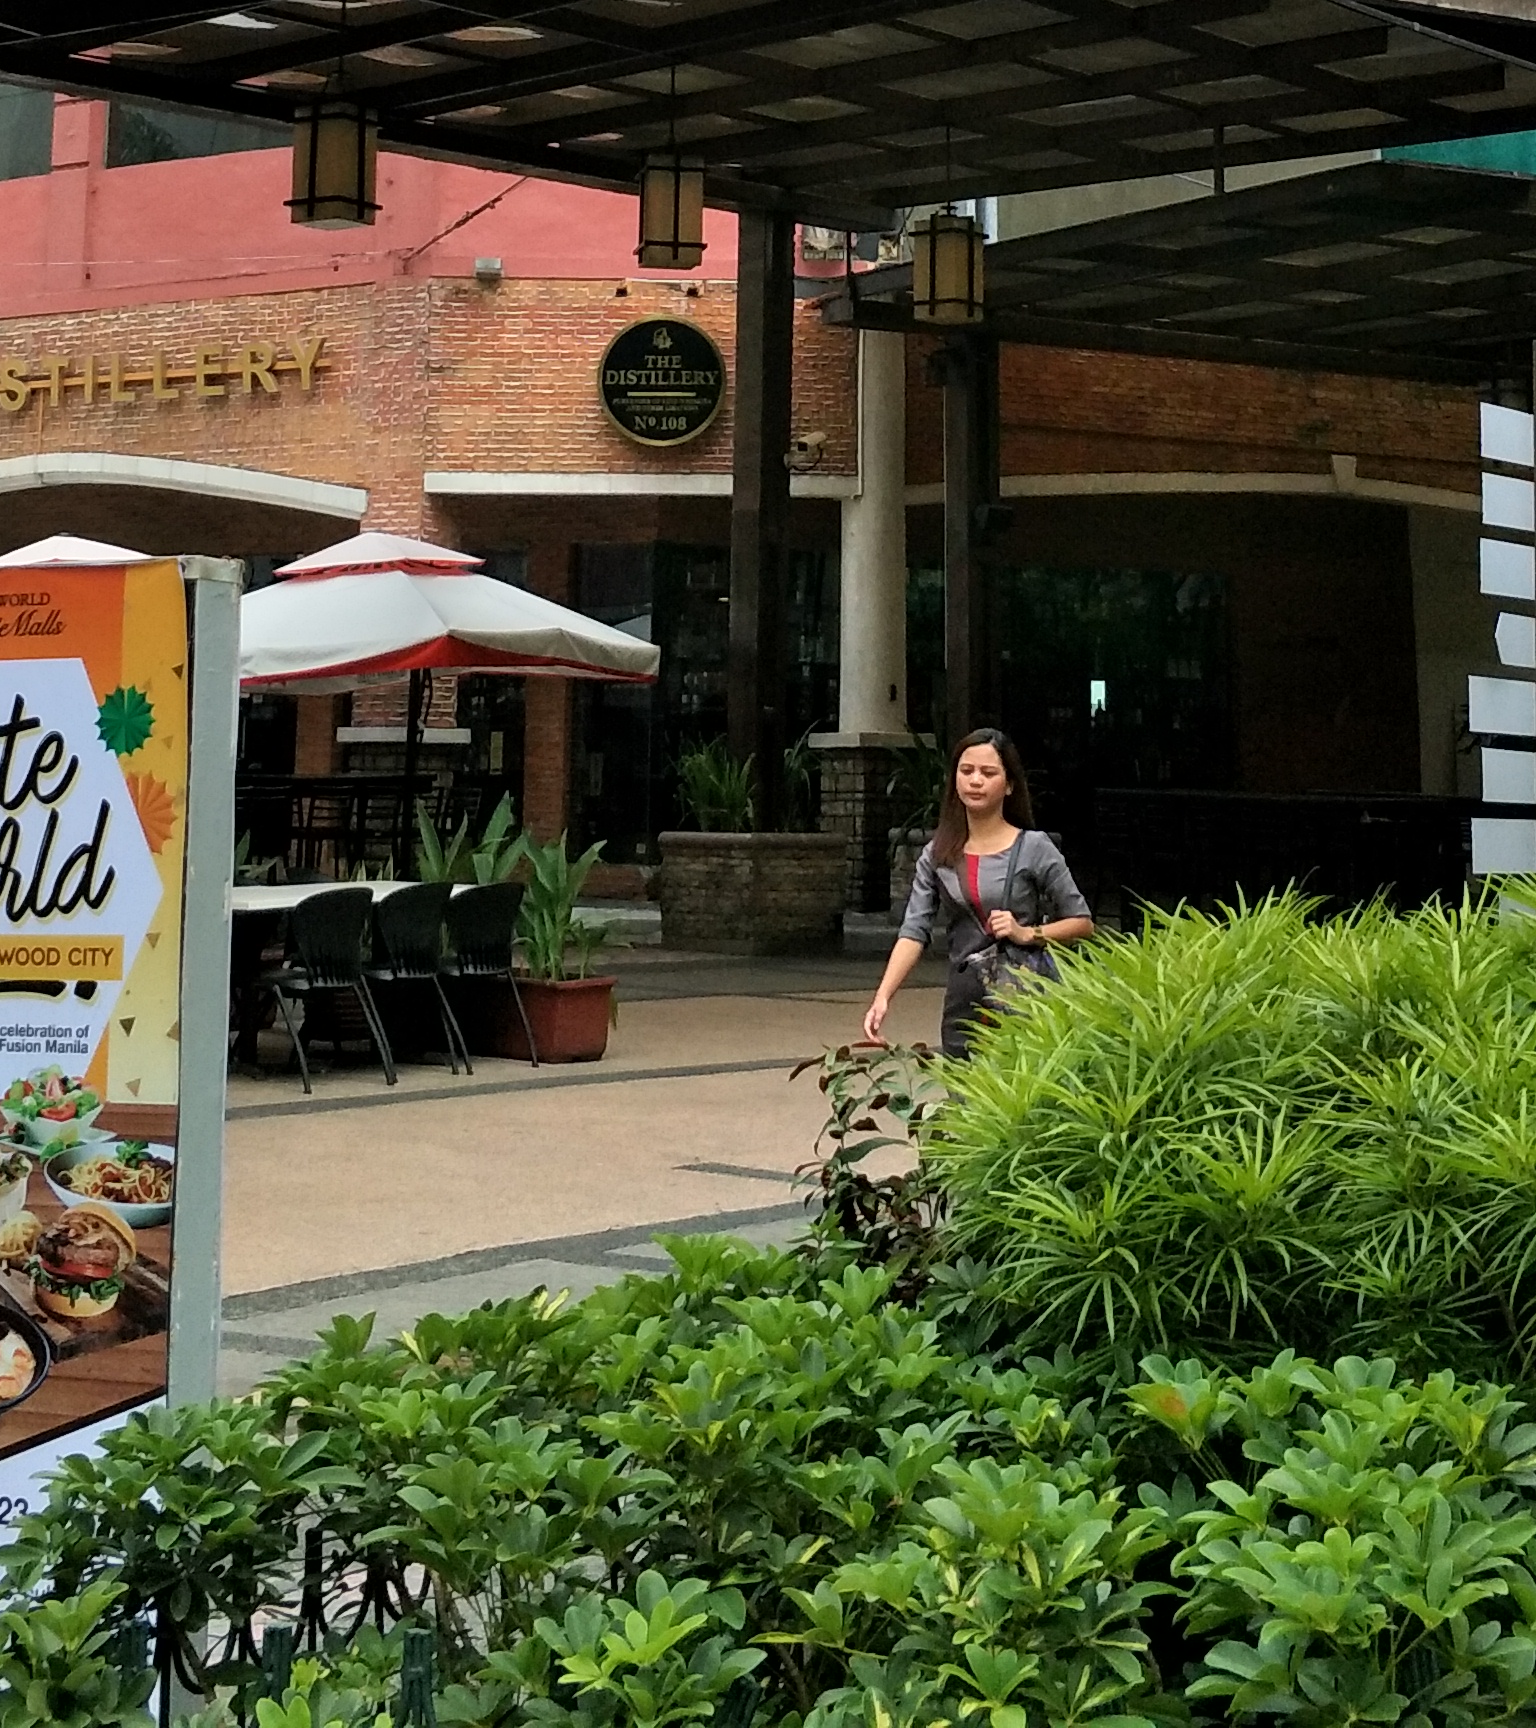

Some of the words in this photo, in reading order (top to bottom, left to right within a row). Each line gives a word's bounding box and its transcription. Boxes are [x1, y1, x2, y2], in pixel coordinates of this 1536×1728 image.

[644, 355, 682, 369] THE
[604, 369, 719, 386] DISTILLERY
[68, 947, 114, 967] CITY
[0, 1023, 73, 1038] celebration
[76, 1024, 90, 1038] of
[0, 1038, 42, 1053] Fusion
[45, 1039, 89, 1054] Manila
